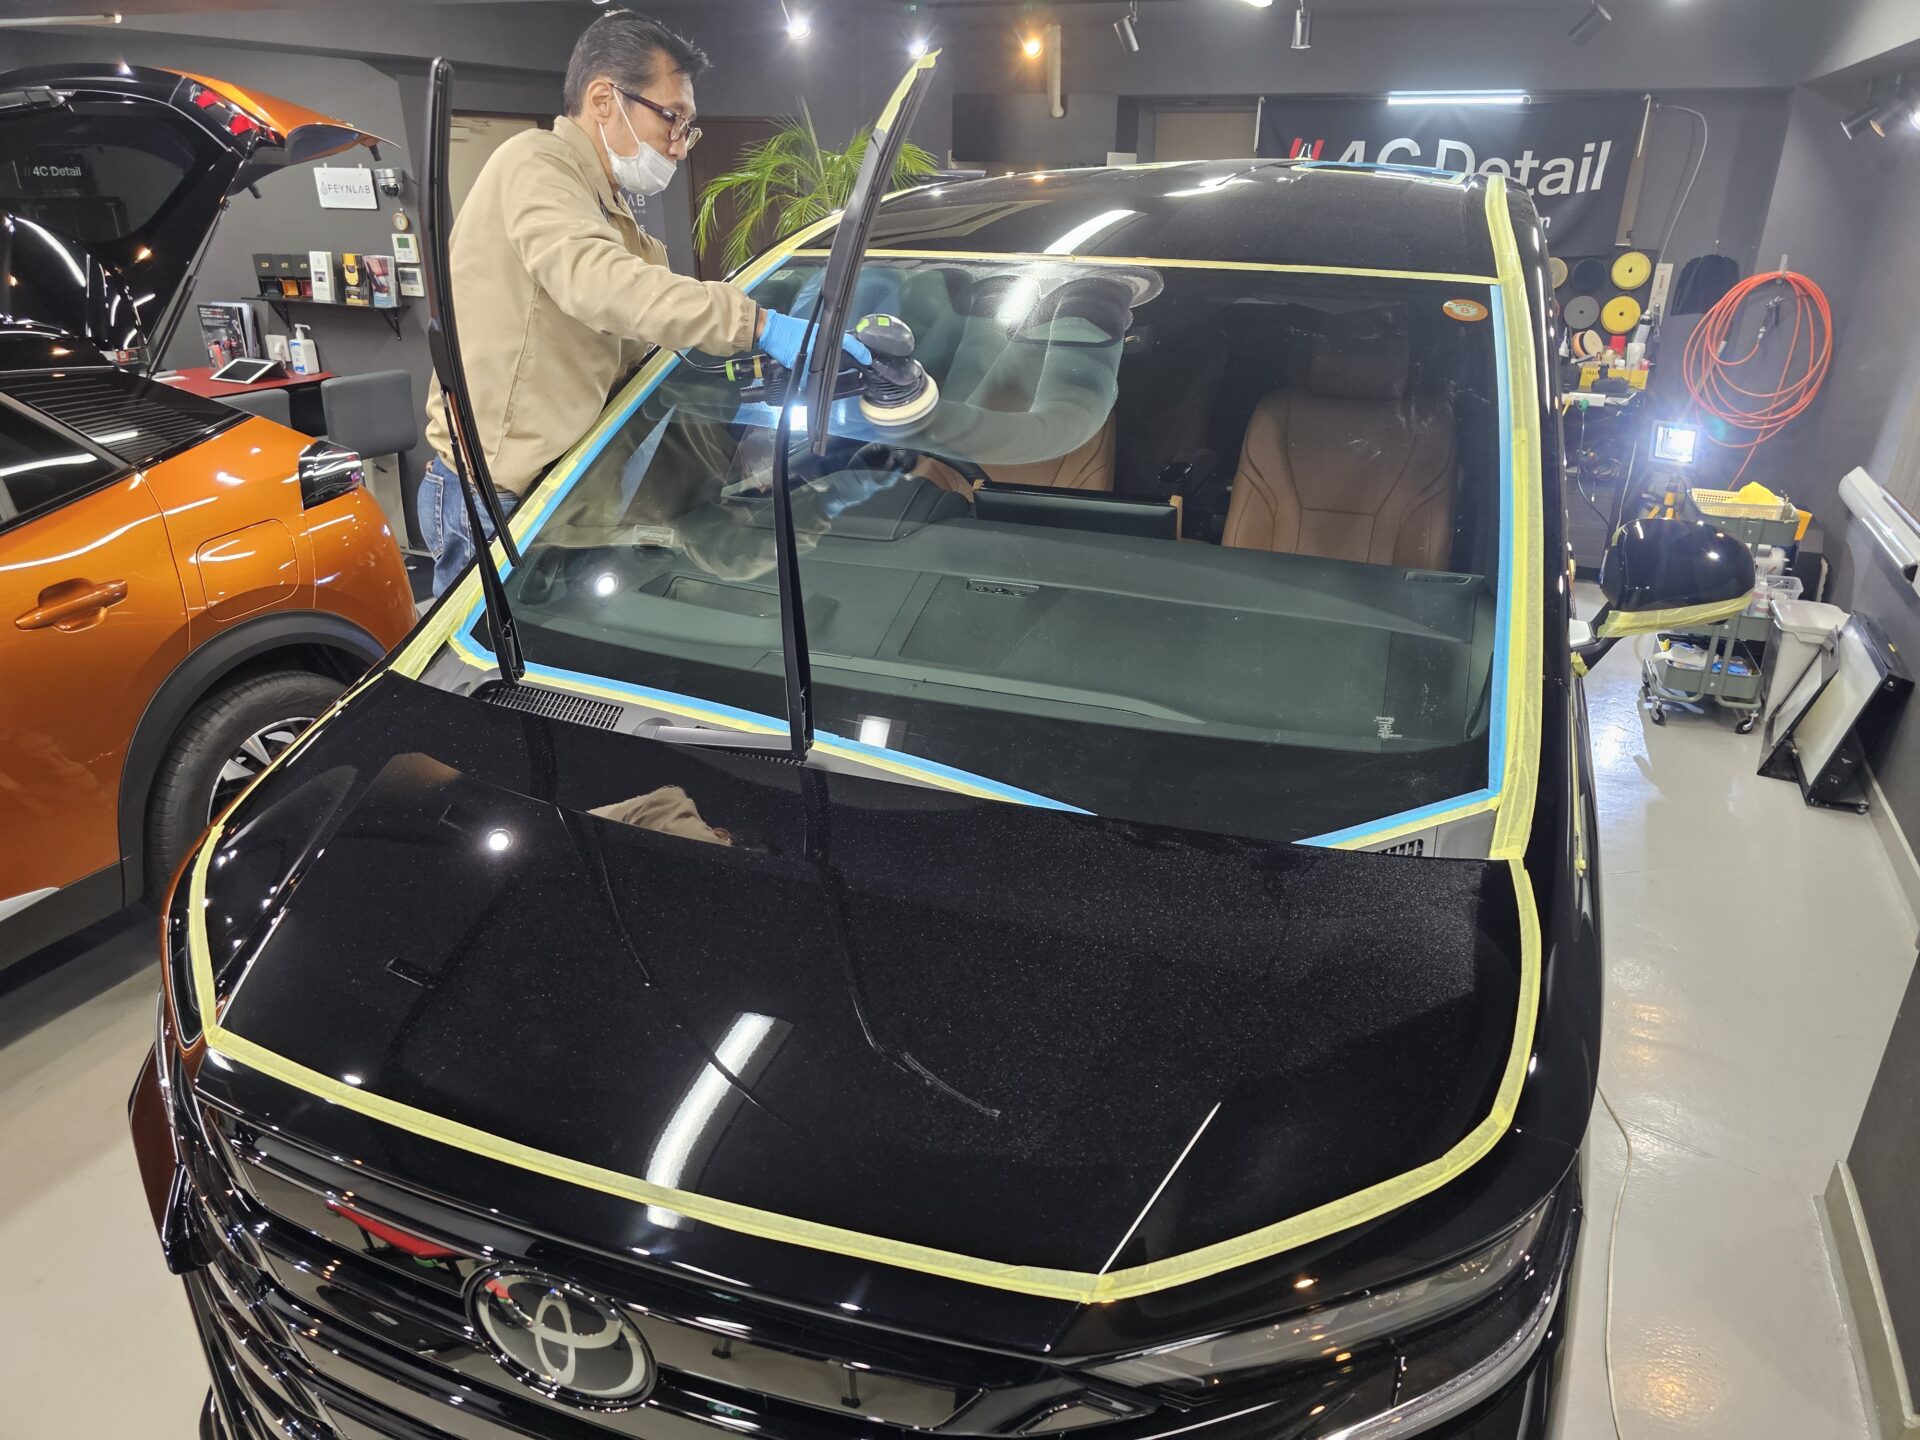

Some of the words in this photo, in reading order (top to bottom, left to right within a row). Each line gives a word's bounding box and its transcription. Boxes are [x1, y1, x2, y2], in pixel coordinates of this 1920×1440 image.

[33, 166, 48, 176] 4C
[50, 166, 82, 176] Detail
[327, 184, 371, 194] FEYNLAB
